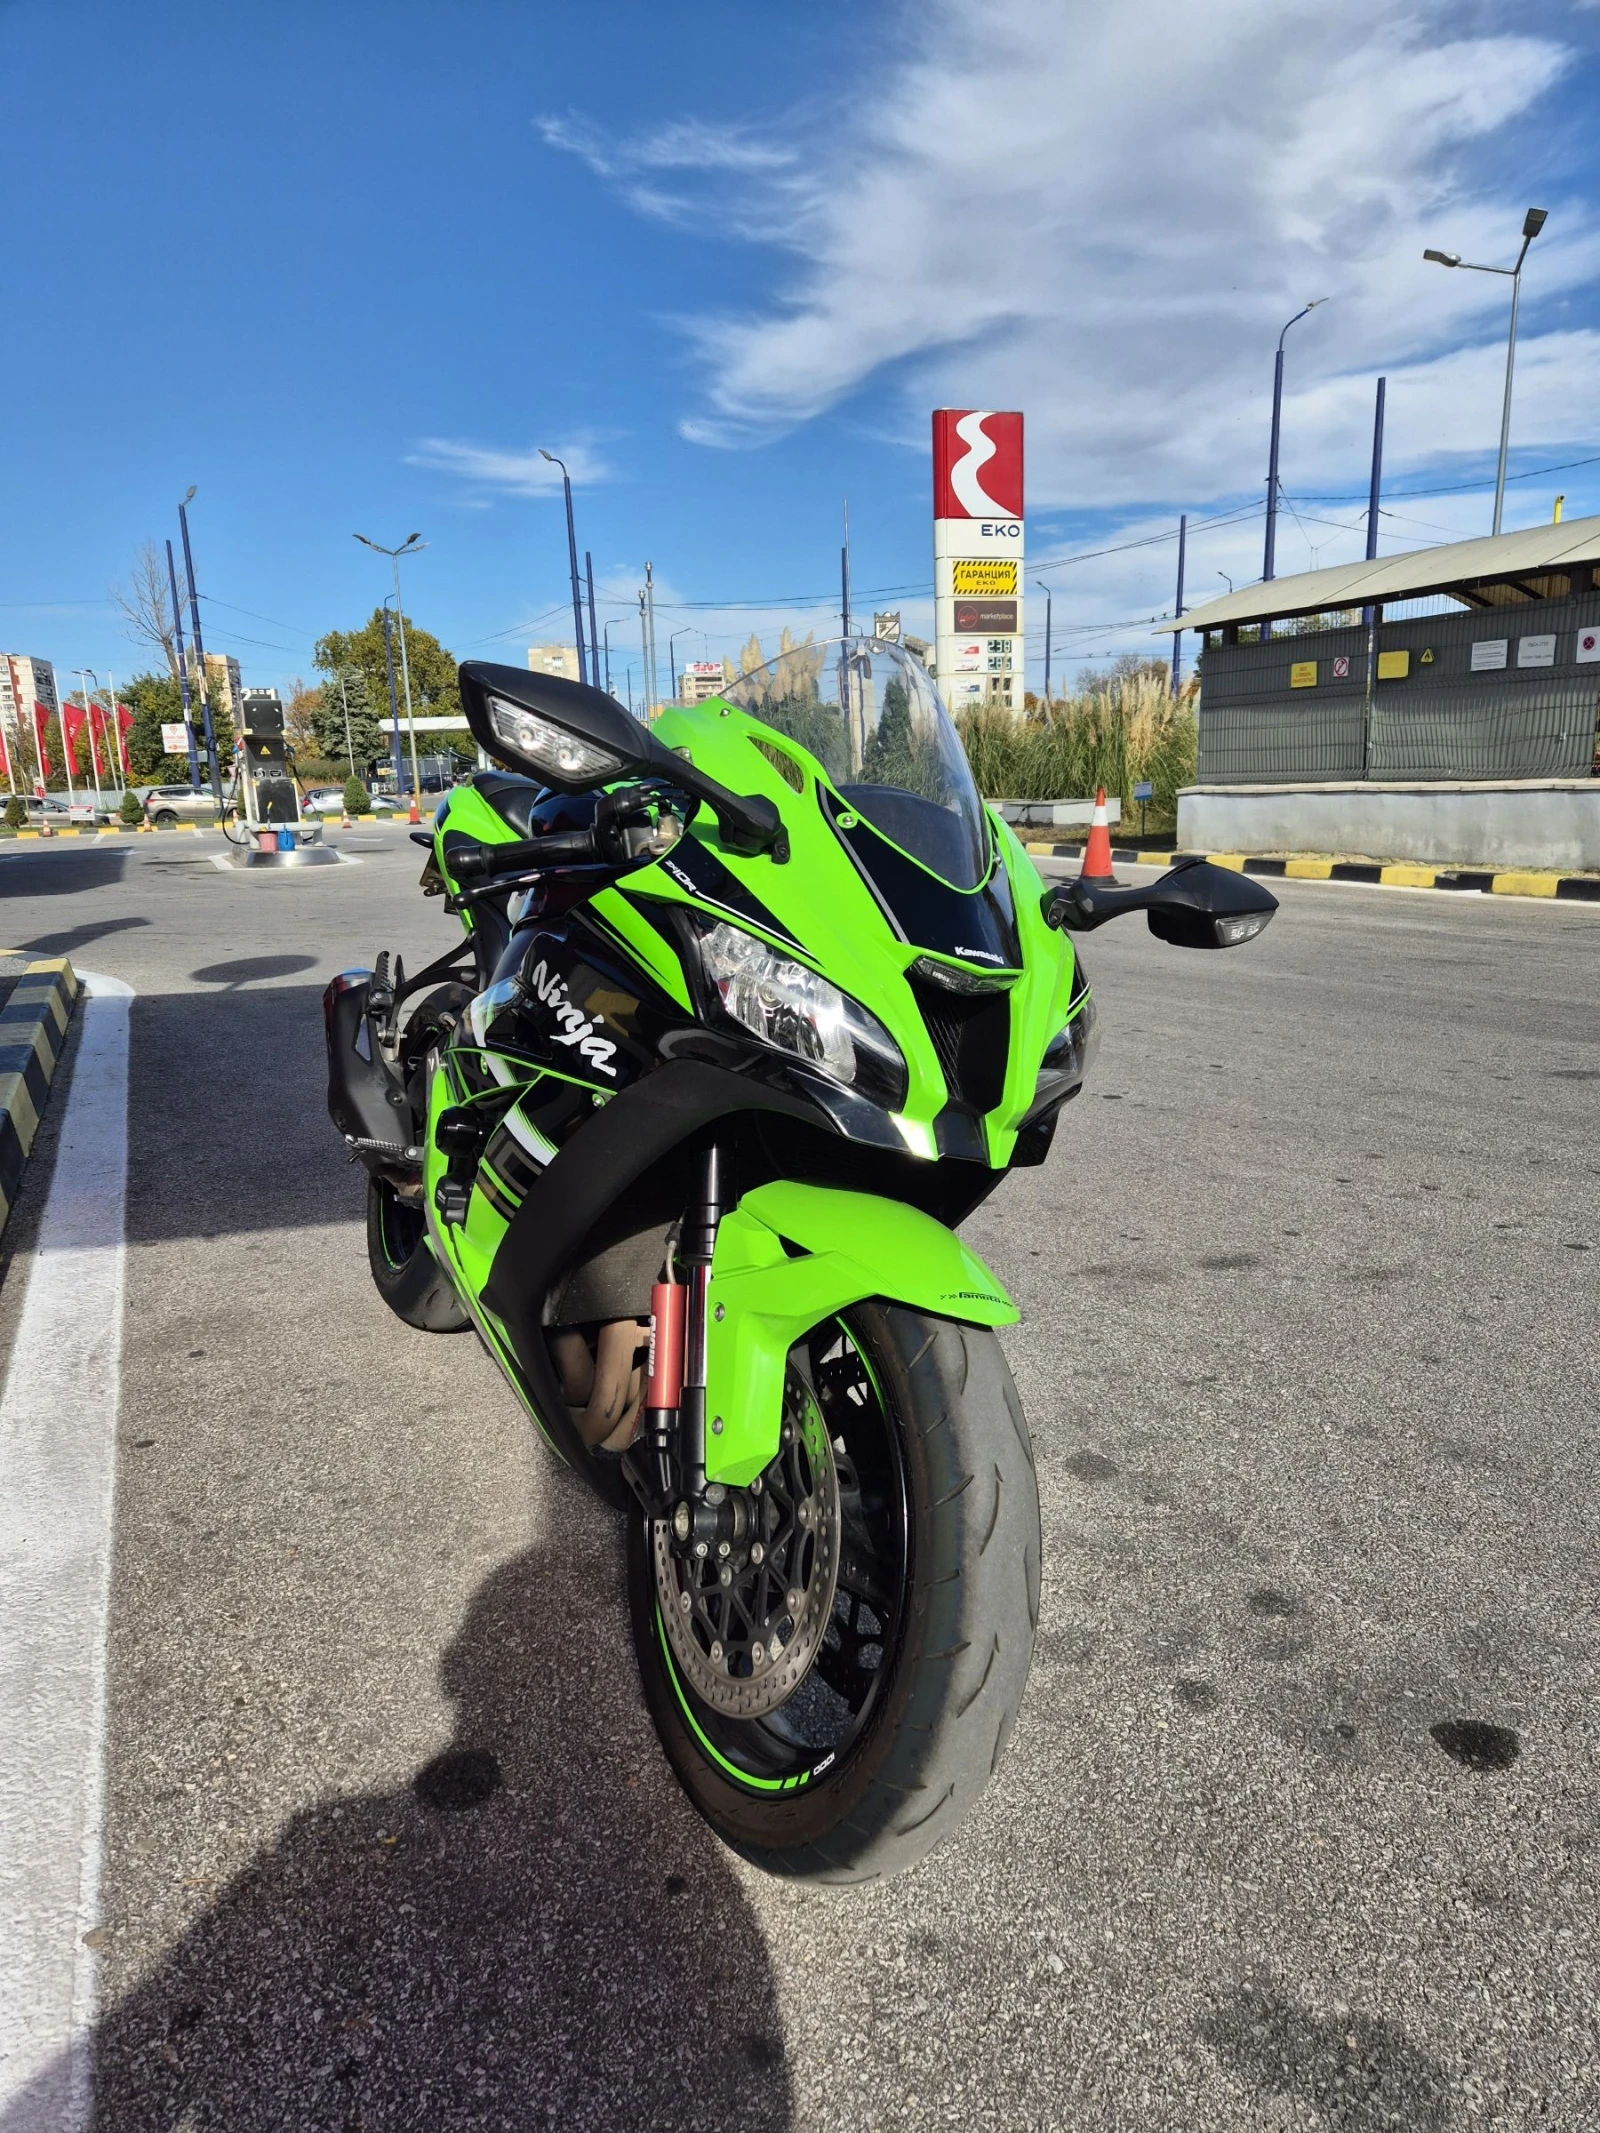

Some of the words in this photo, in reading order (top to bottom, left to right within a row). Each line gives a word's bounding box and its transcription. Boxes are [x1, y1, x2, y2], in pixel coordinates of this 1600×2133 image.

[981, 524, 1020, 537] EKO
[960, 570, 1011, 579] ГАРАНЦИЯ
[980, 612, 1014, 621] marketplace
[954, 946, 1004, 965] Kawasaki
[532, 959, 617, 1077] Ninja
